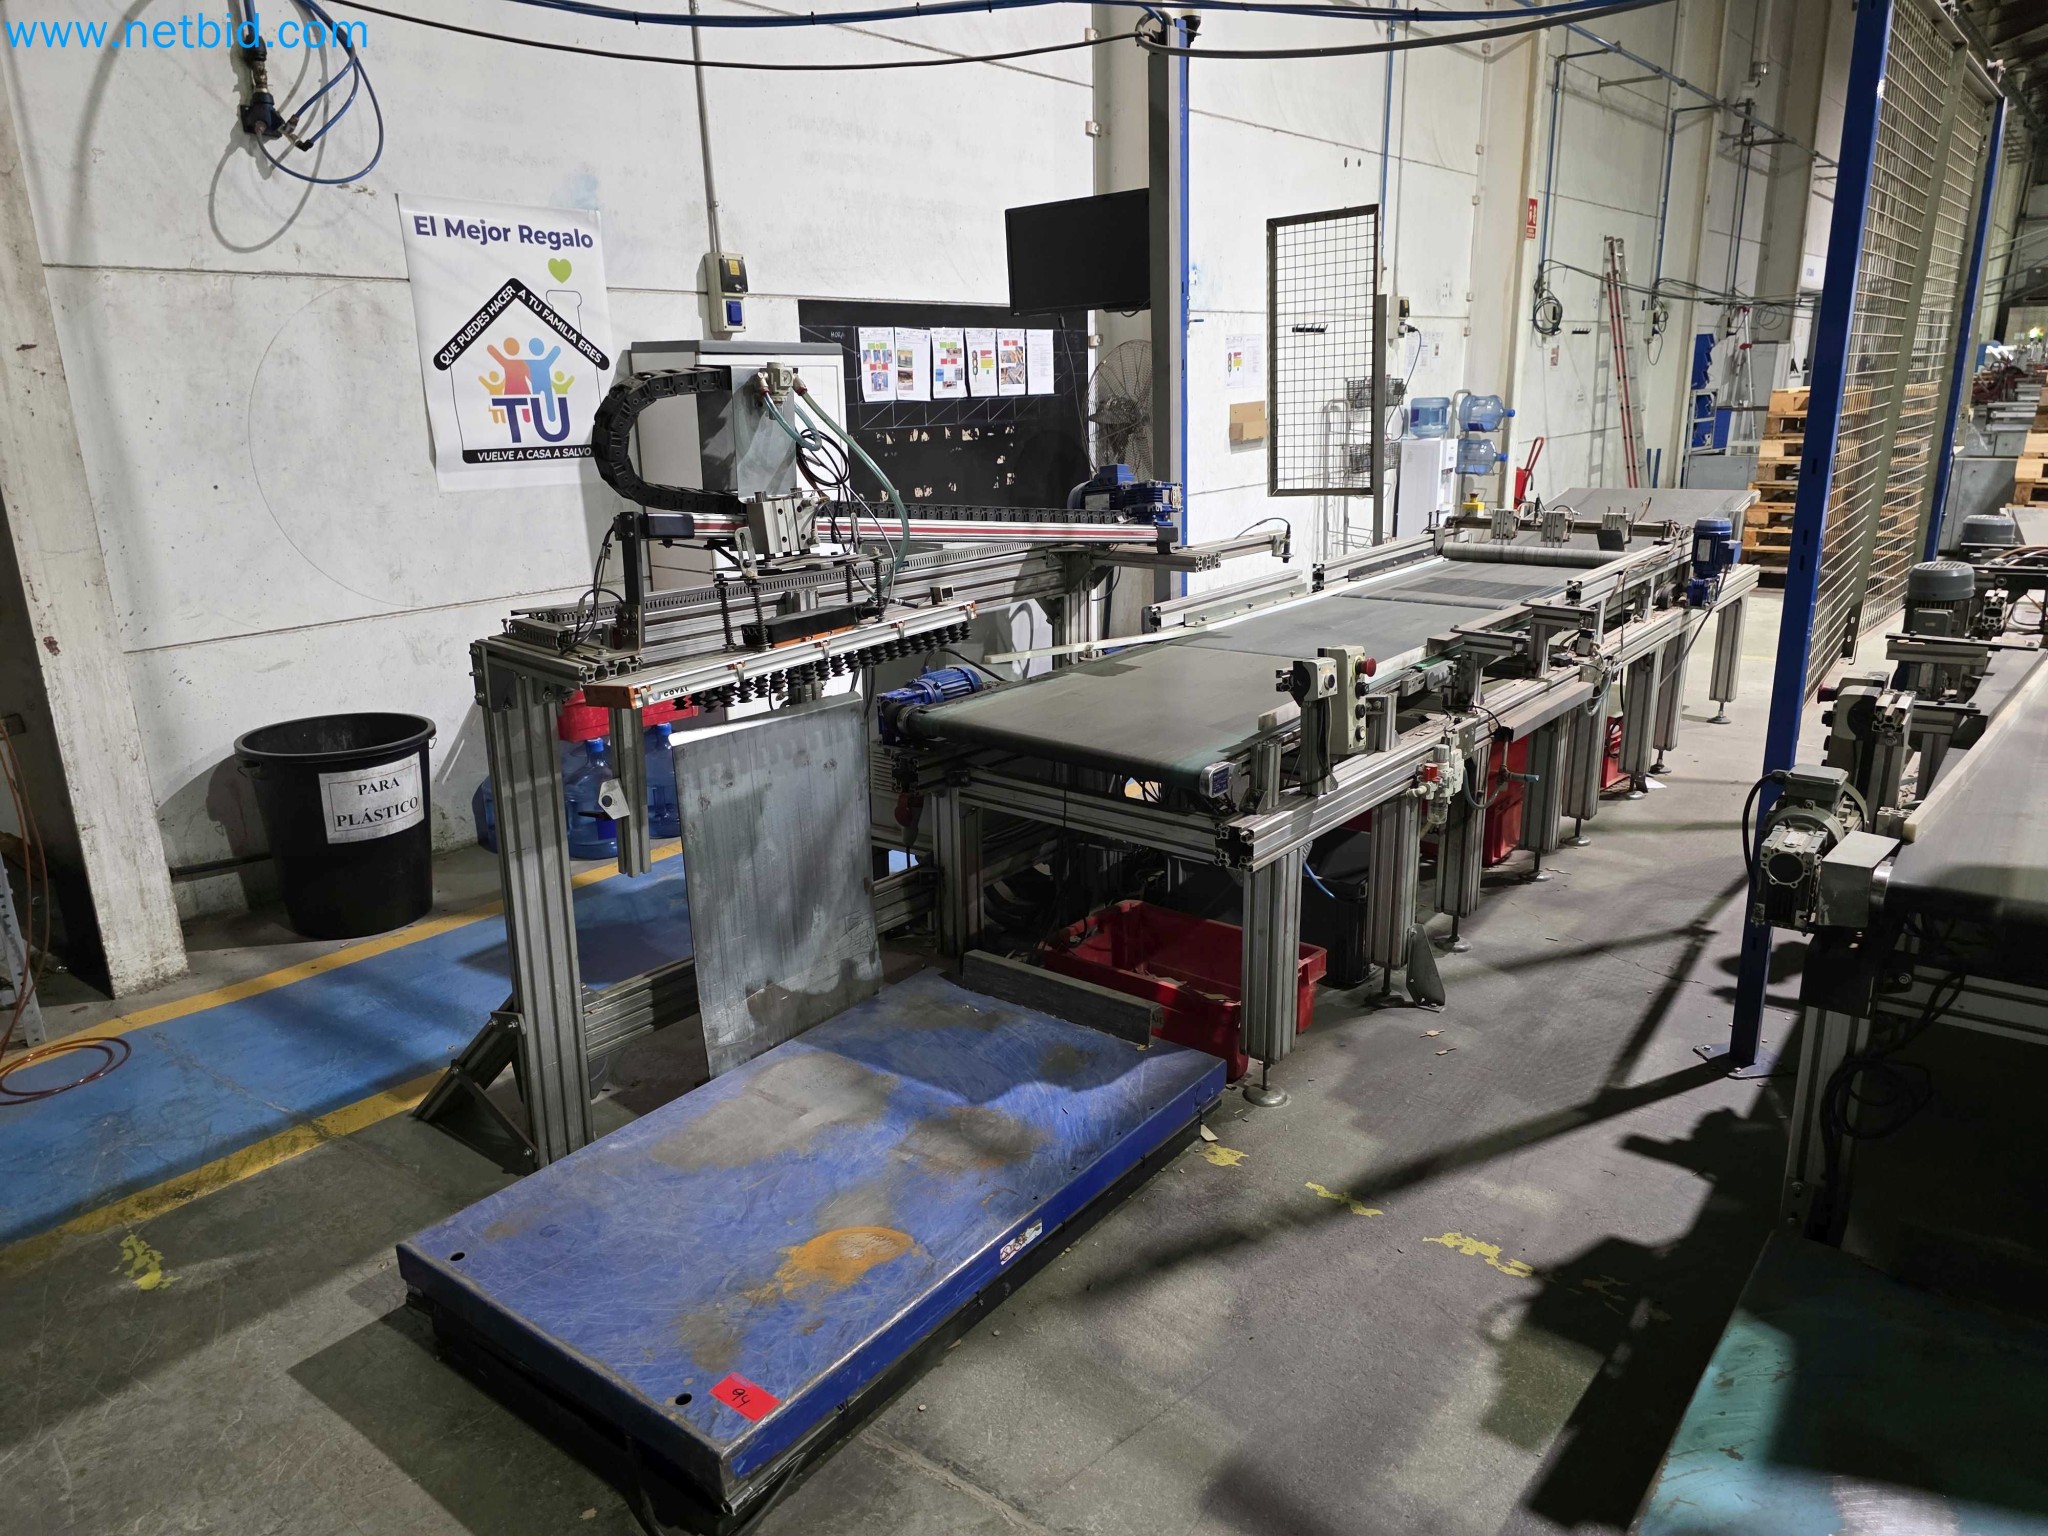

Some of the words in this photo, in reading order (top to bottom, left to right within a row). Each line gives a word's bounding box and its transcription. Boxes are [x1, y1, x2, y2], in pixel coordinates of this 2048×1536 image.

[414, 215, 437, 236] El
[444, 218, 511, 245] Mejor
[518, 225, 594, 251] Regalo
[439, 343, 460, 366] QUE
[457, 312, 490, 345] PUEDES
[487, 285, 516, 315] HACER
[518, 288, 527, 299] A
[528, 295, 543, 313] TU
[541, 309, 578, 343] FAMILIA
[577, 338, 602, 364] ERES
[492, 397, 571, 443] TU
[477, 450, 515, 462] VUELVE
[517, 450, 525, 460] A
[526, 449, 551, 460] CASA
[553, 448, 561, 459] A
[562, 447, 592, 458] SALVO
[358, 777, 400, 795] PARA
[336, 796, 419, 827] PLÁSTICO
[732, 1388, 751, 1408] 94
